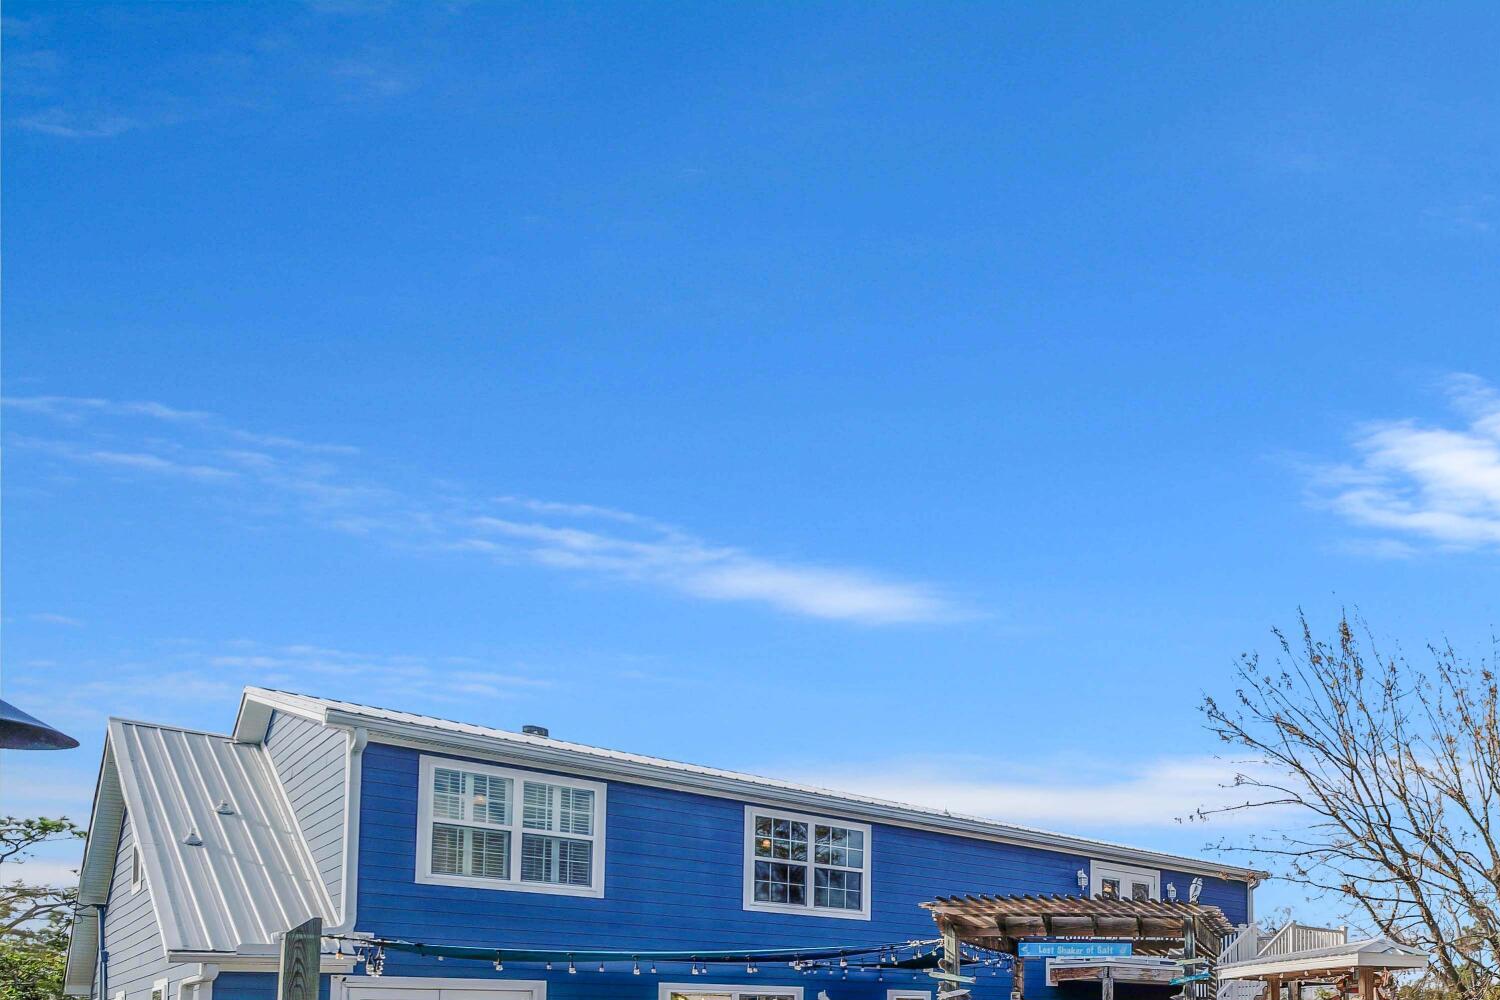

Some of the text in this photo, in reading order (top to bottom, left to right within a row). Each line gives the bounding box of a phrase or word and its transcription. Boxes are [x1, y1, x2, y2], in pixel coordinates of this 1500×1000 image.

[1039, 945, 1113, 954] Lost Shaker of Salt
